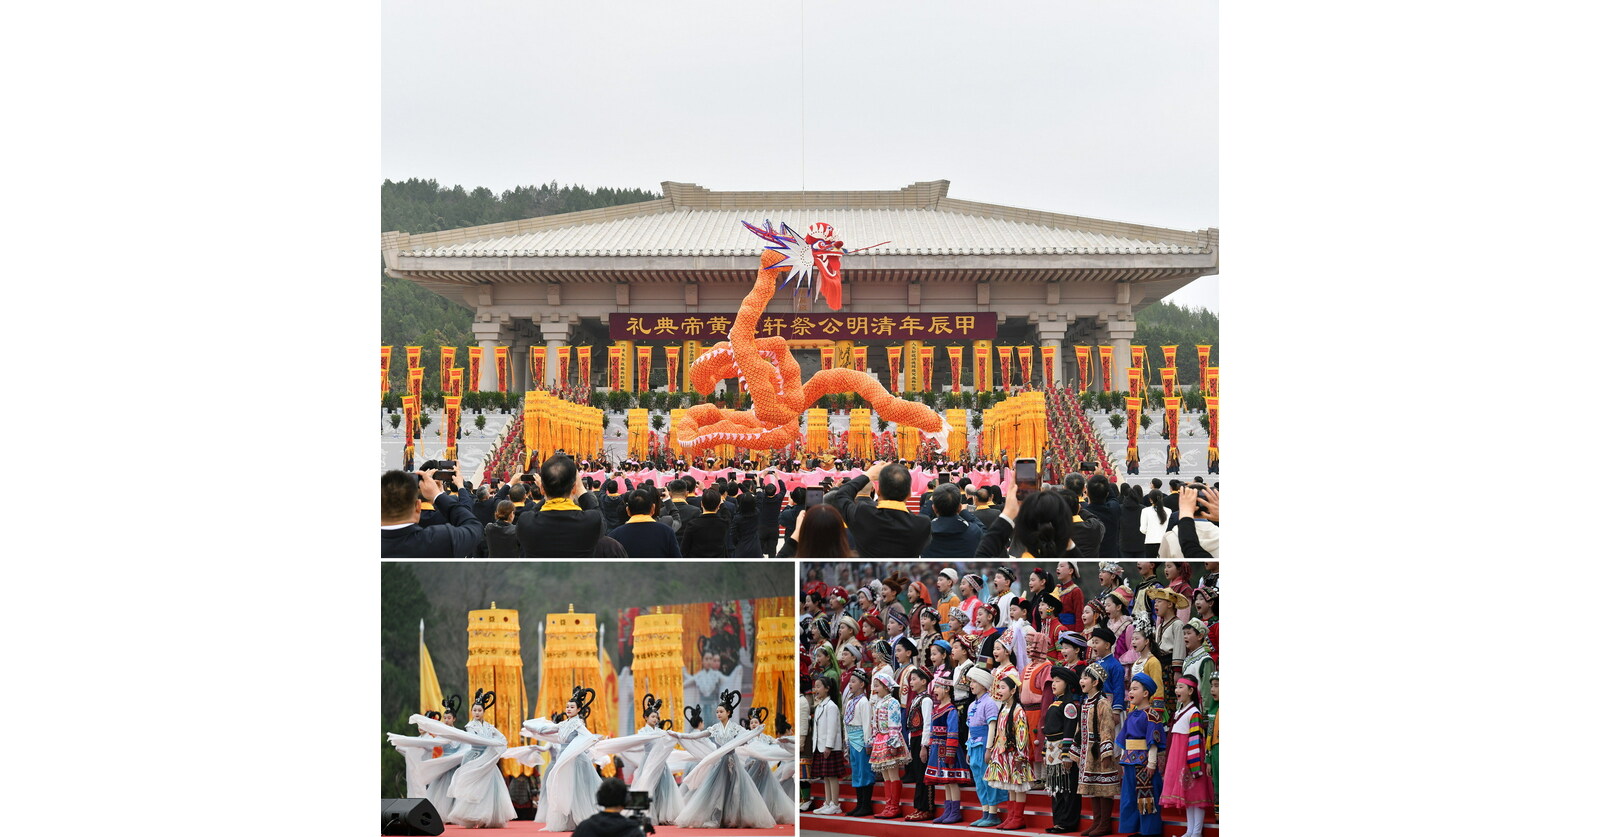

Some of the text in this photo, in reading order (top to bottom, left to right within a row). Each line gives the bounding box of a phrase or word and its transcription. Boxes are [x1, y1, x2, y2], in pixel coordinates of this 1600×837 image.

[626, 316, 975, 336] 甲辰年清明公祭轩黄帝典礼
